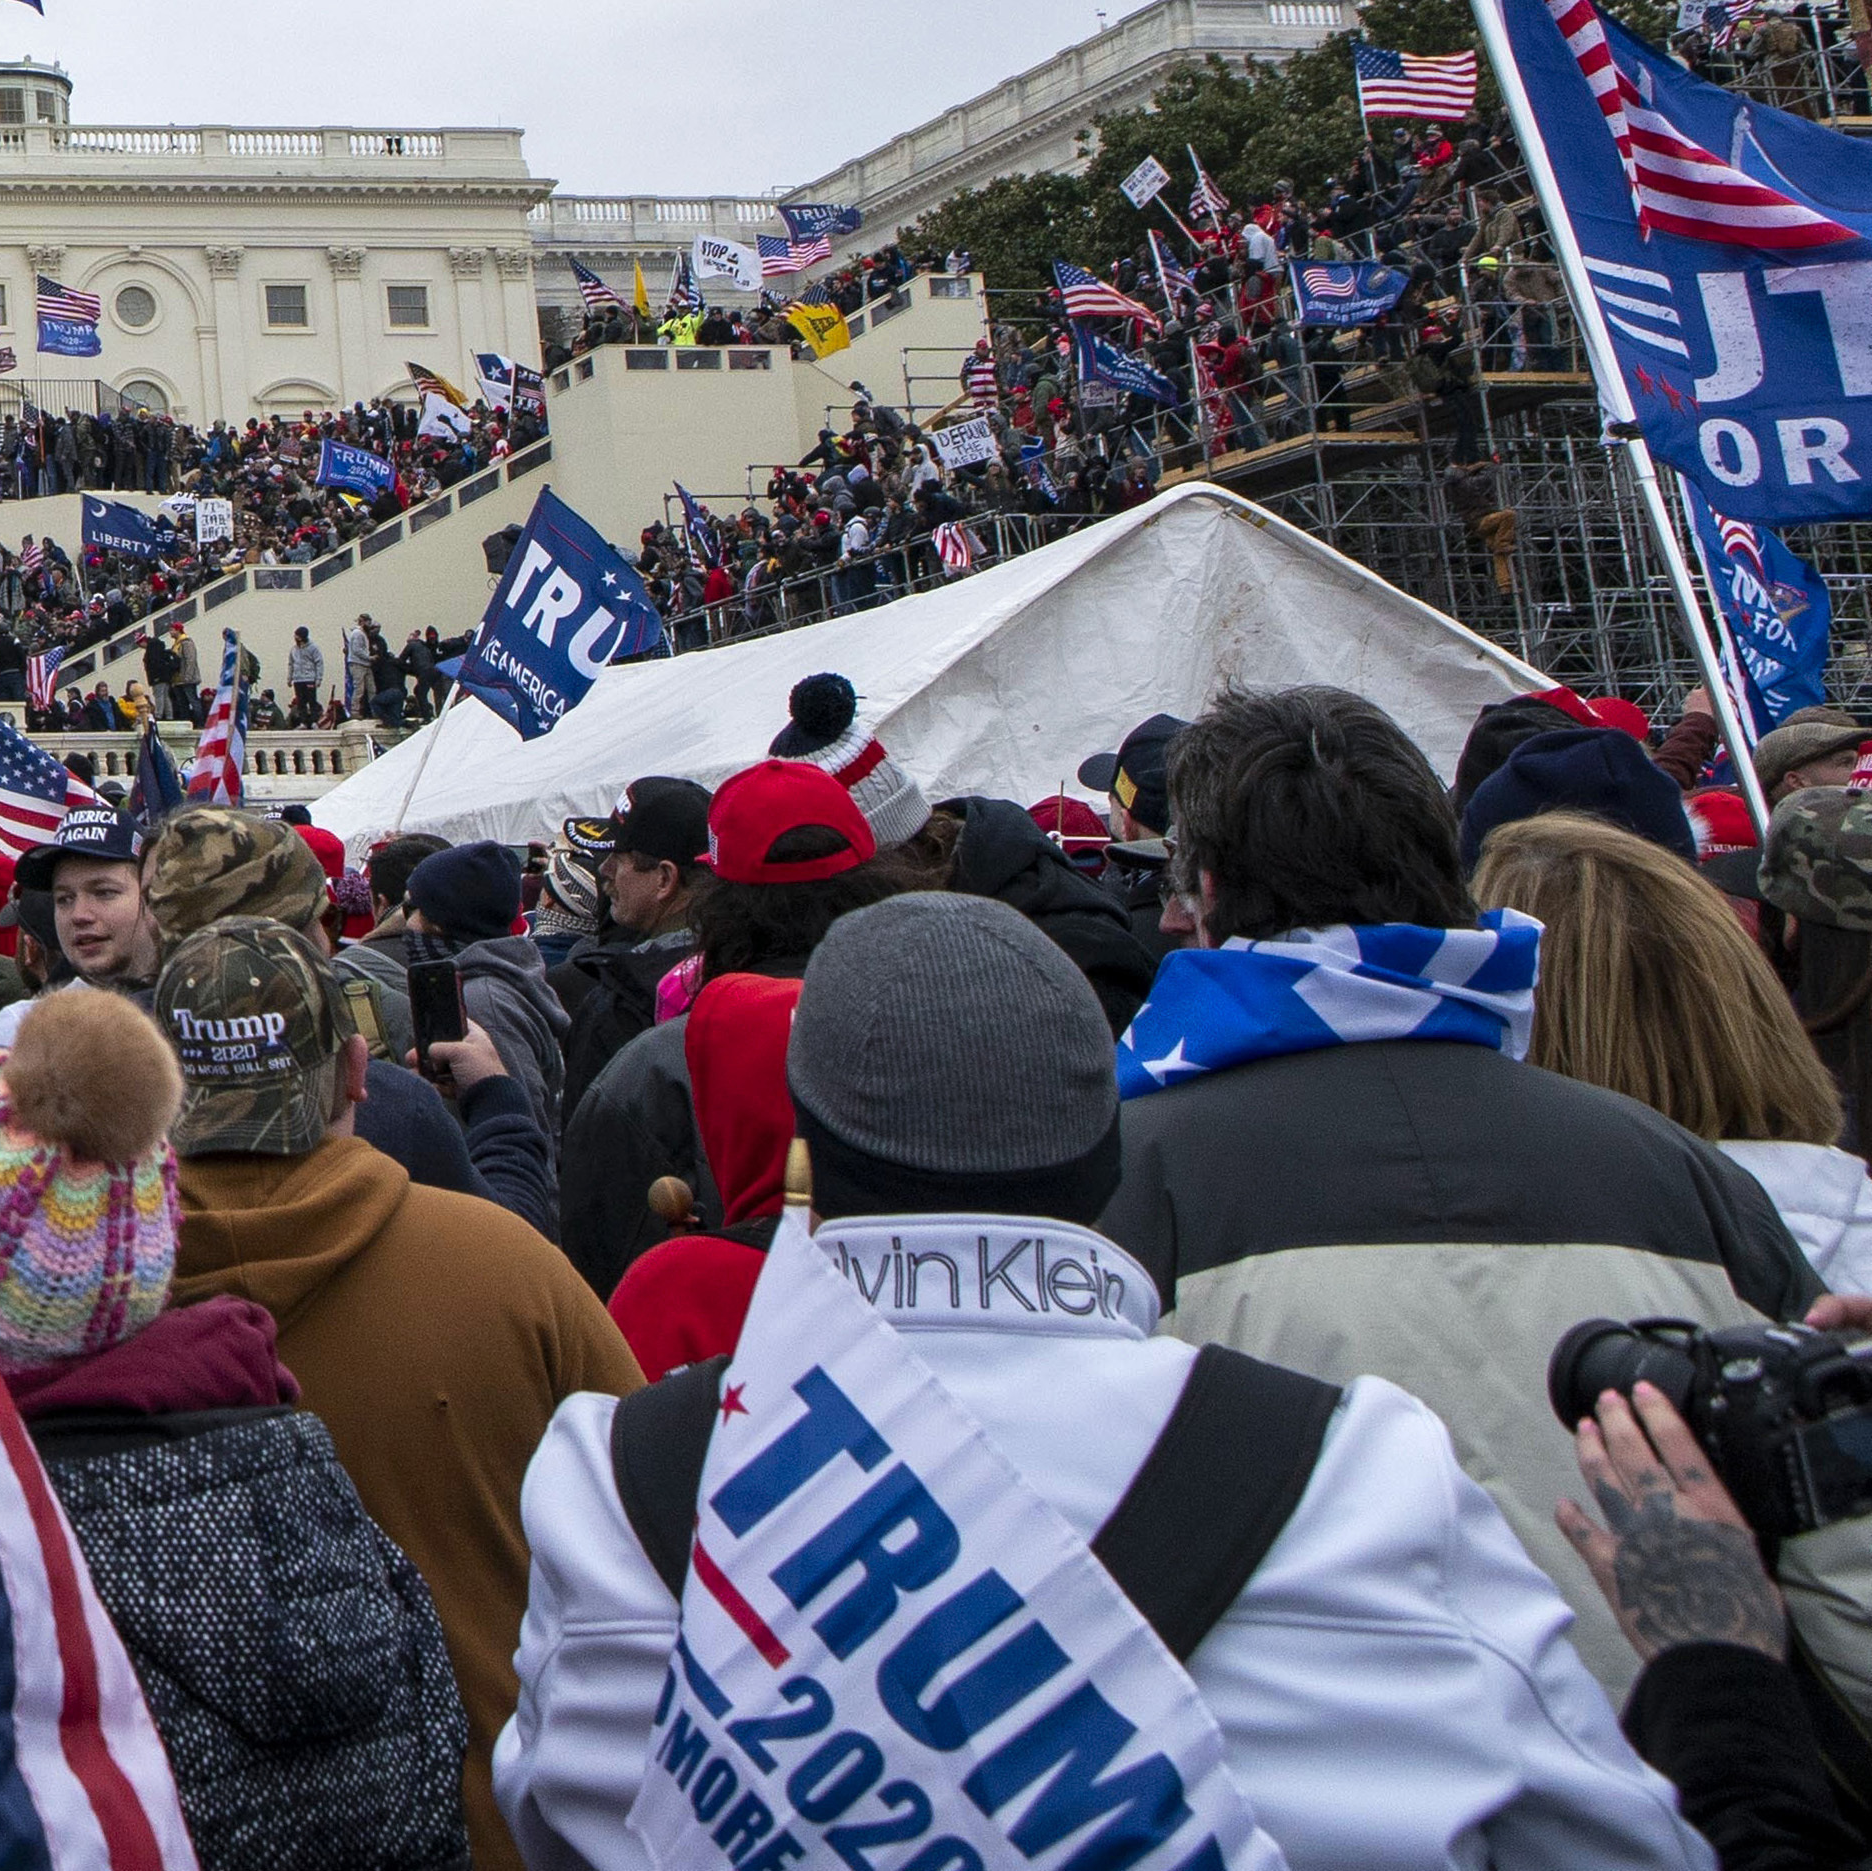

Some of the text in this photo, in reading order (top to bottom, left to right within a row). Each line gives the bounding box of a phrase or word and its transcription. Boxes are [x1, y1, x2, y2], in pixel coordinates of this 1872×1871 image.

[702, 240, 729, 259] STOP
[1326, 312, 1349, 322] FOR
[937, 419, 992, 448] DEFUND
[951, 448, 993, 467] MEDIA
[954, 441, 982, 455] THE
[331, 447, 390, 476] TRUMP
[91, 530, 152, 554] LIBERTY
[498, 652, 565, 718] AMERICA
[65, 827, 107, 842] AGAIN
[173, 1008, 286, 1048] Trump
[211, 1043, 257, 1062] 2020
[198, 1063, 229, 1075] MORE
[232, 1061, 263, 1075] BULL
[267, 1056, 292, 1071] SHIT
[834, 1235, 1125, 1321] lvin Klein
